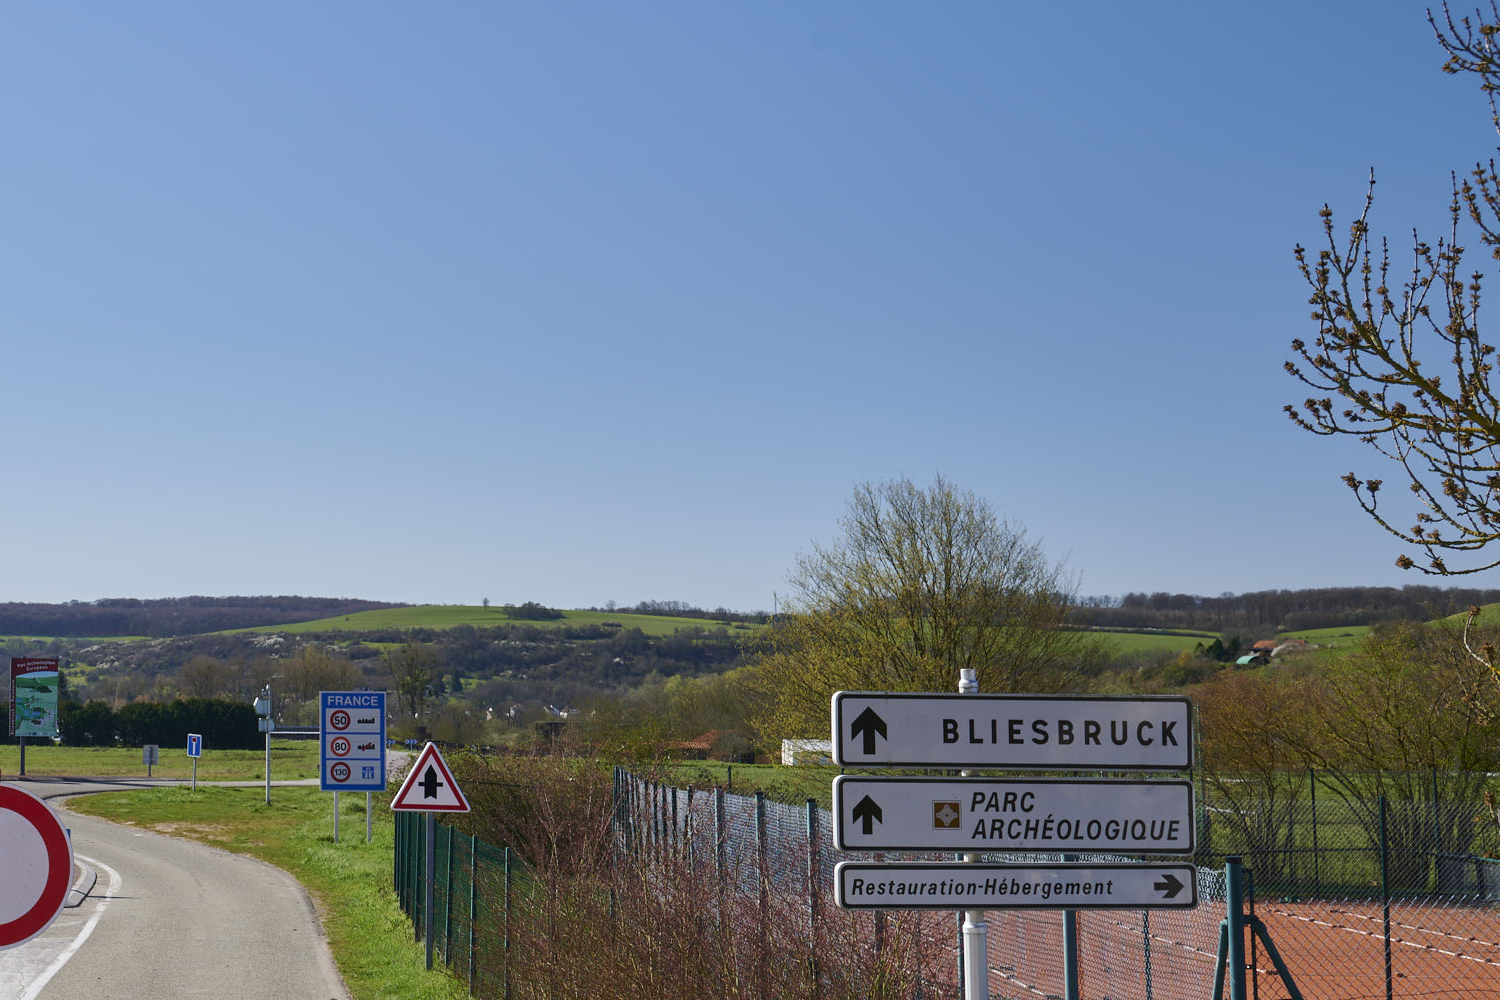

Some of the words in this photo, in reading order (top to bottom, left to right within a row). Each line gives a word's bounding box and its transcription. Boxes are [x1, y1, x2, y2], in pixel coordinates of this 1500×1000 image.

[327, 696, 379, 706] FRANCE
[335, 716, 347, 725] 50
[942, 718, 1179, 747] BLIESBRUCK
[335, 742, 347, 751] 80
[334, 768, 347, 776] 130
[970, 792, 1036, 813] PARC
[971, 815, 1181, 842] ARCHÉOLOGIQUE
[852, 878, 1114, 898] Restauration-Hébergement
